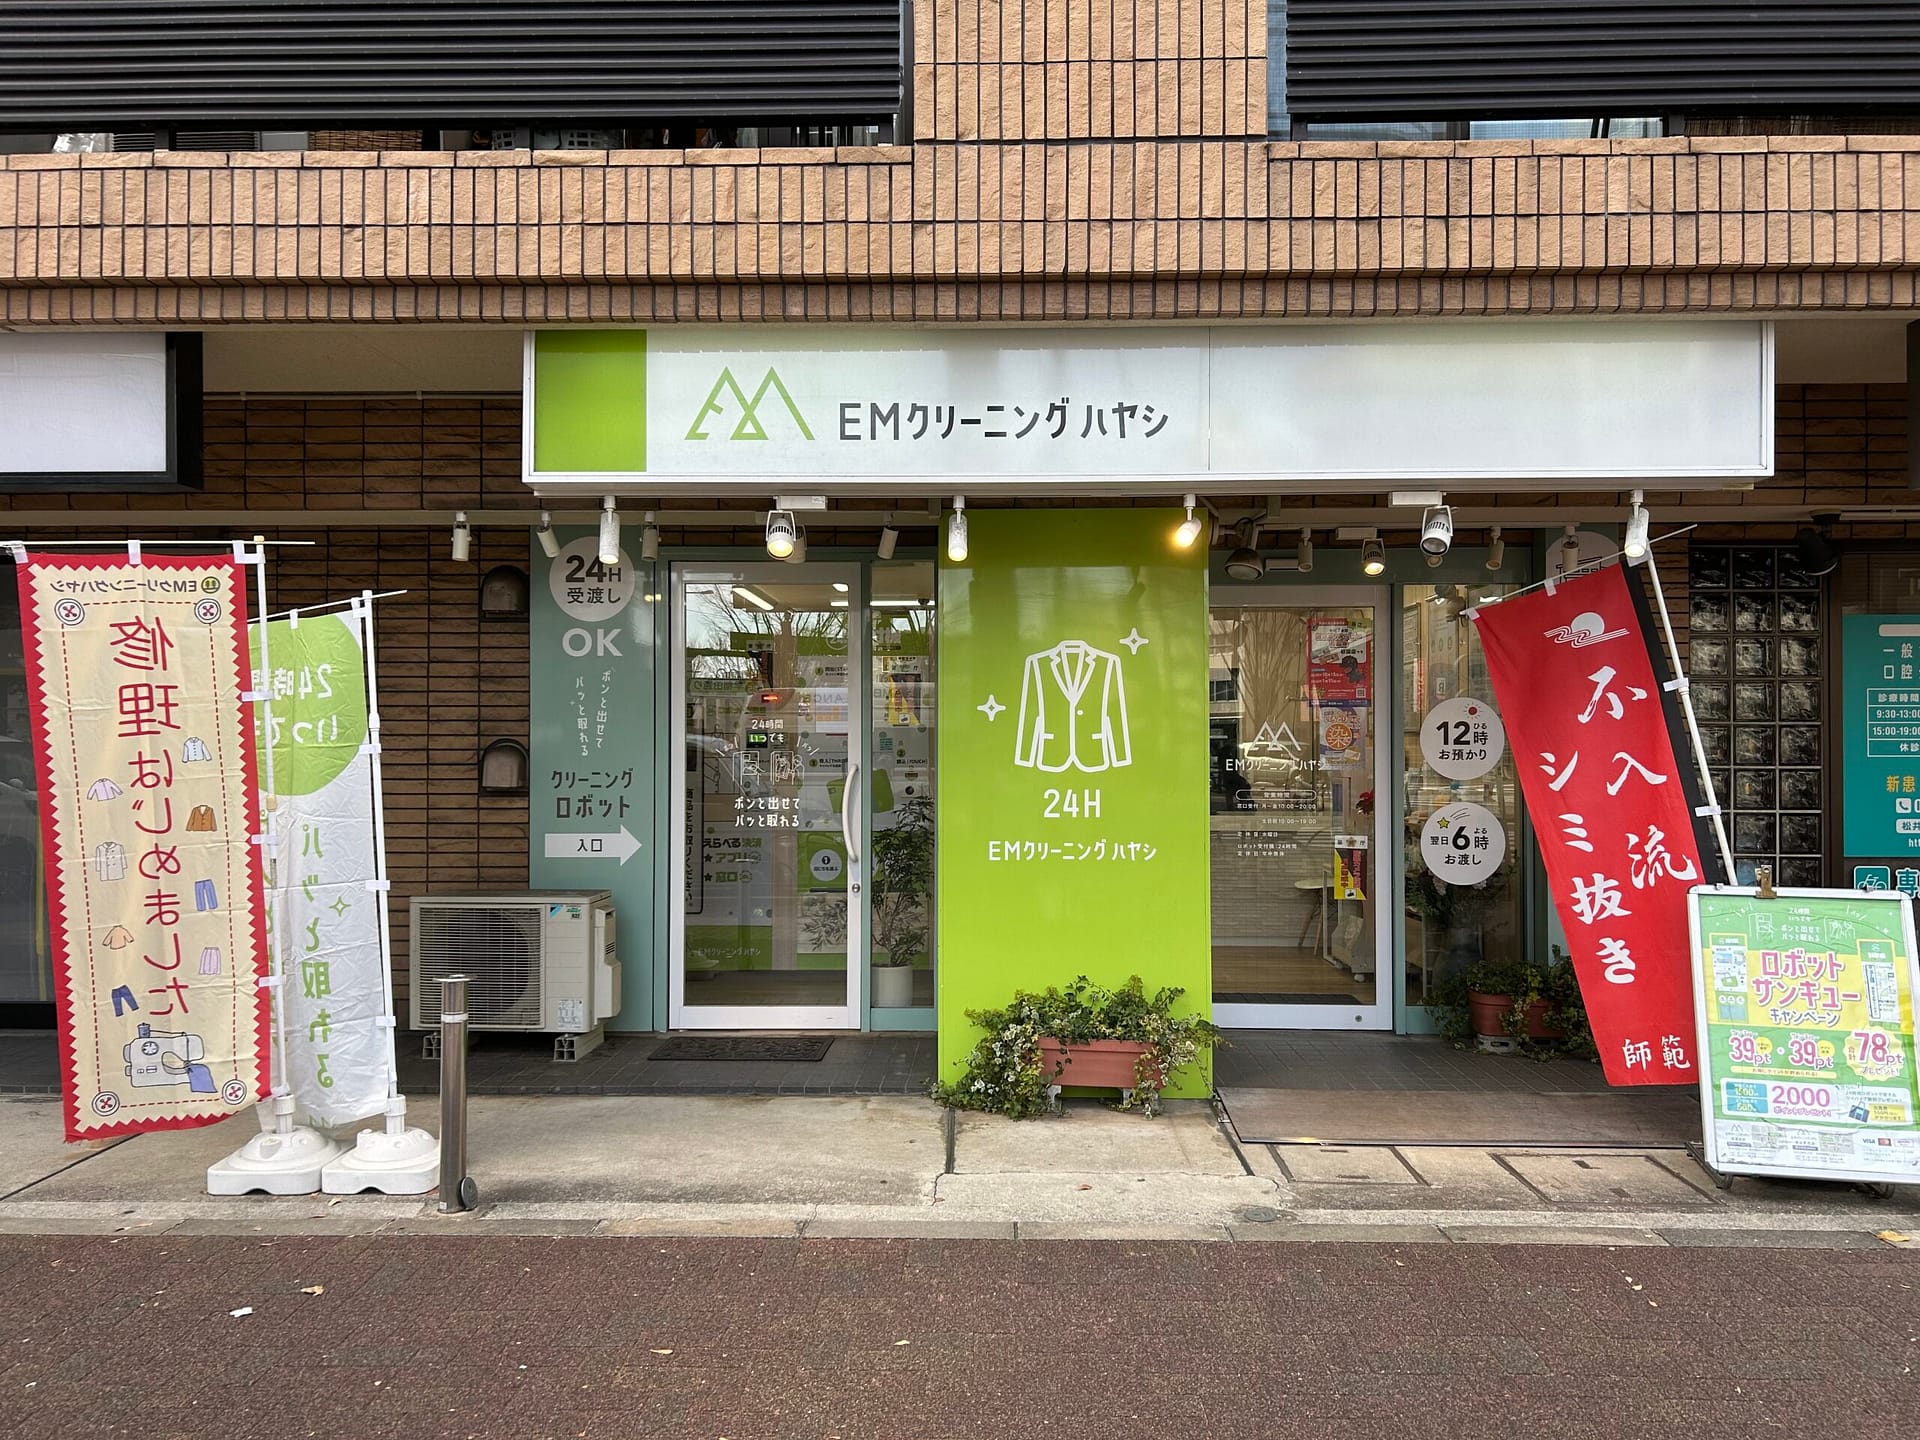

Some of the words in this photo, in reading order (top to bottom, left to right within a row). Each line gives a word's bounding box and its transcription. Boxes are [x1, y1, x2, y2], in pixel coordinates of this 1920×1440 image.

[840, 397, 1168, 441] EMクリーニングハヤシ
[565, 555, 622, 583] 24H
[567, 587, 621, 604] 受渡し
[562, 627, 623, 657] OK
[1883, 643, 1920, 659] 一般
[1884, 665, 1920, 680] 口腔
[1878, 693, 1920, 703] 診療時間
[575, 676, 589, 757] パッと取れる
[752, 719, 784, 730] 24時間
[1474, 723, 1488, 731] ひる
[750, 733, 784, 743] いつでも
[1436, 720, 1489, 747] 12時
[1438, 748, 1488, 761] お預かり
[551, 768, 634, 790] クリーニング
[1577, 665, 1698, 889] 不入流
[1886, 775, 1916, 794] 新患
[556, 794, 630, 819] ロボット
[1044, 788, 1101, 818] 24H
[734, 814, 800, 828] パッと取れる
[577, 838, 603, 853] 入口
[989, 838, 1157, 861] EMクリーニングハヤシ
[1430, 826, 1489, 851] 翌日6時
[1908, 838, 1920, 848] htt
[1444, 853, 1482, 866] お渡し
[1540, 750, 1636, 985] シミ抜き
[1895, 866, 1920, 899] 専
[1761, 949, 1845, 981] ロボット
[1752, 977, 1861, 1011] サンキュー
[1769, 1006, 1840, 1026] キャンペーン
[1621, 1035, 1691, 1072] 師範
[1730, 1036, 1772, 1065] 39pt
[1790, 1039, 1834, 1069] 39pt
[1854, 1032, 1904, 1066] 78pt
[1772, 1086, 1831, 1108] 2,000
